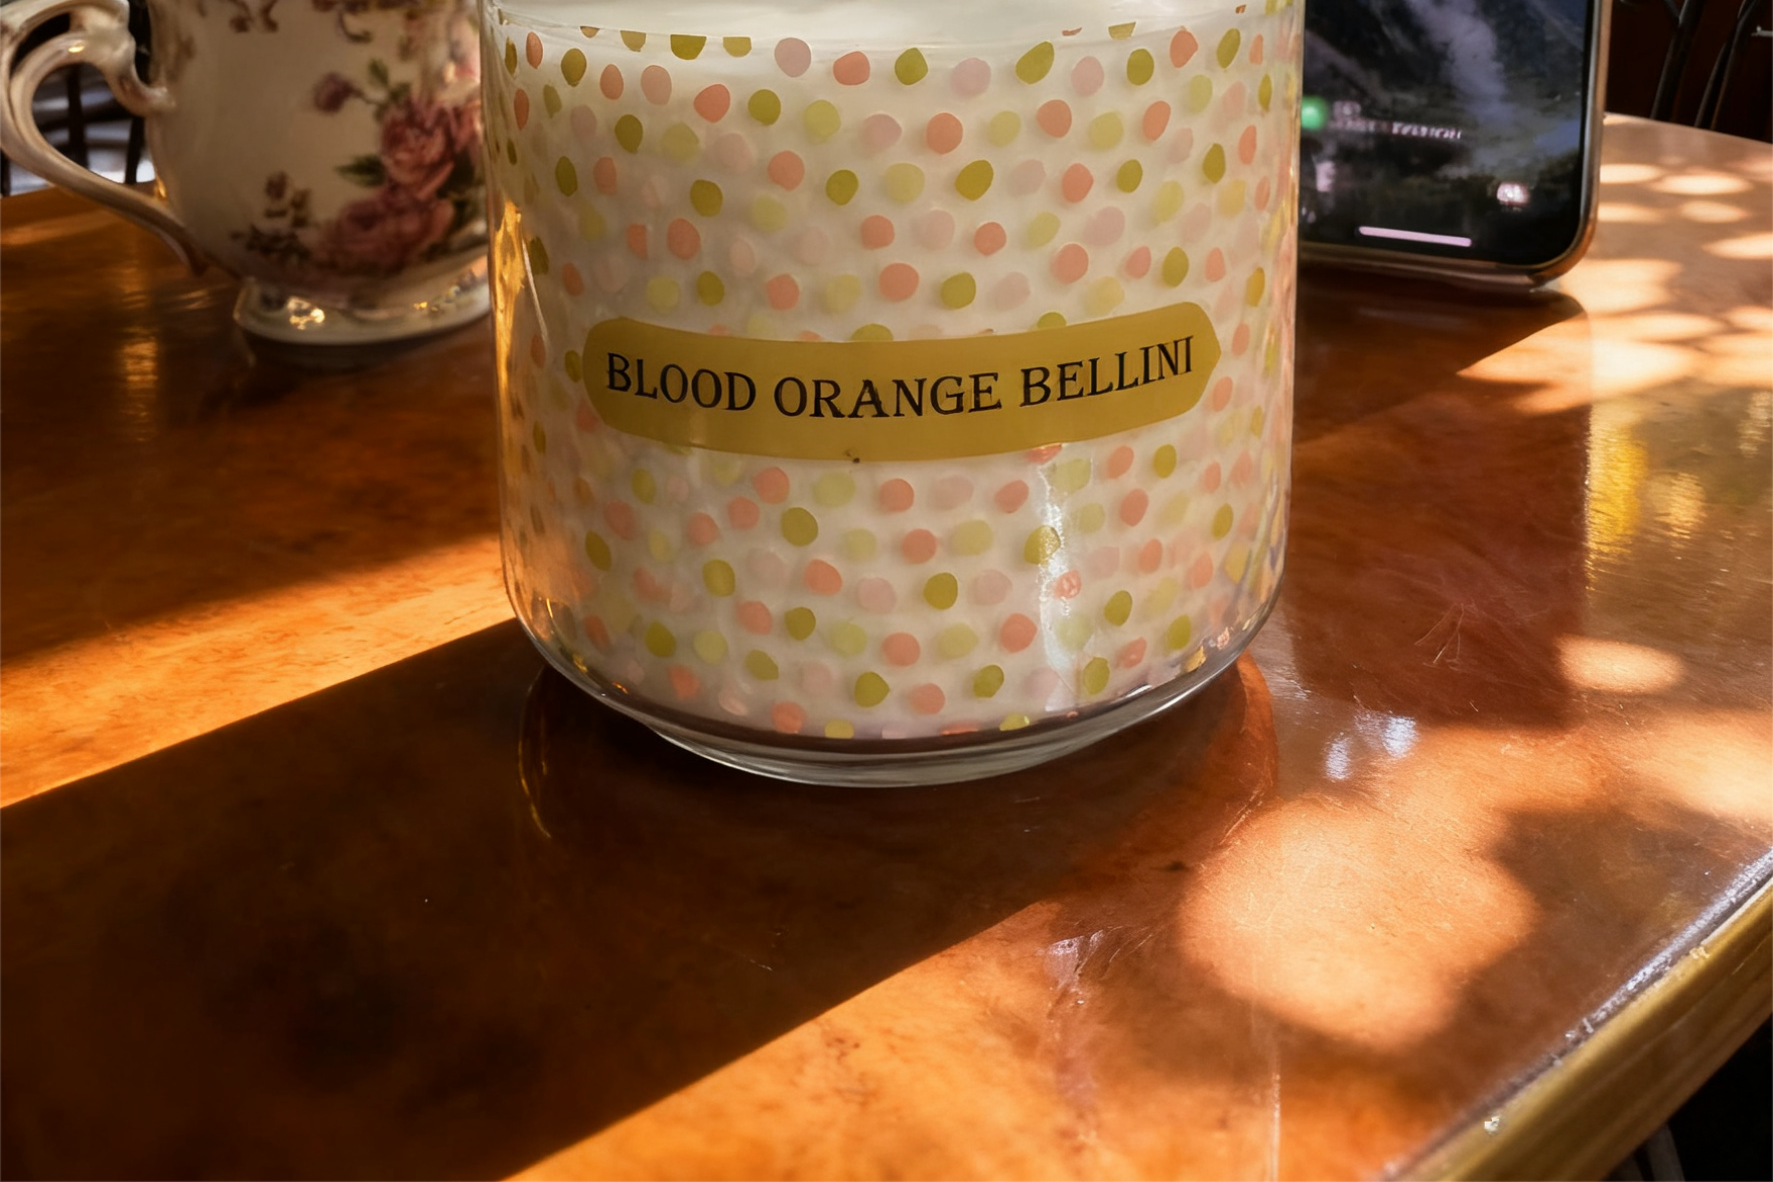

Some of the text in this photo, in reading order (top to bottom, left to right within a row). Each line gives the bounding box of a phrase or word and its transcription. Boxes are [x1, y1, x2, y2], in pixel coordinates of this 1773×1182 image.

[606, 335, 1194, 420] BLOOD ORANGE BELLINI
